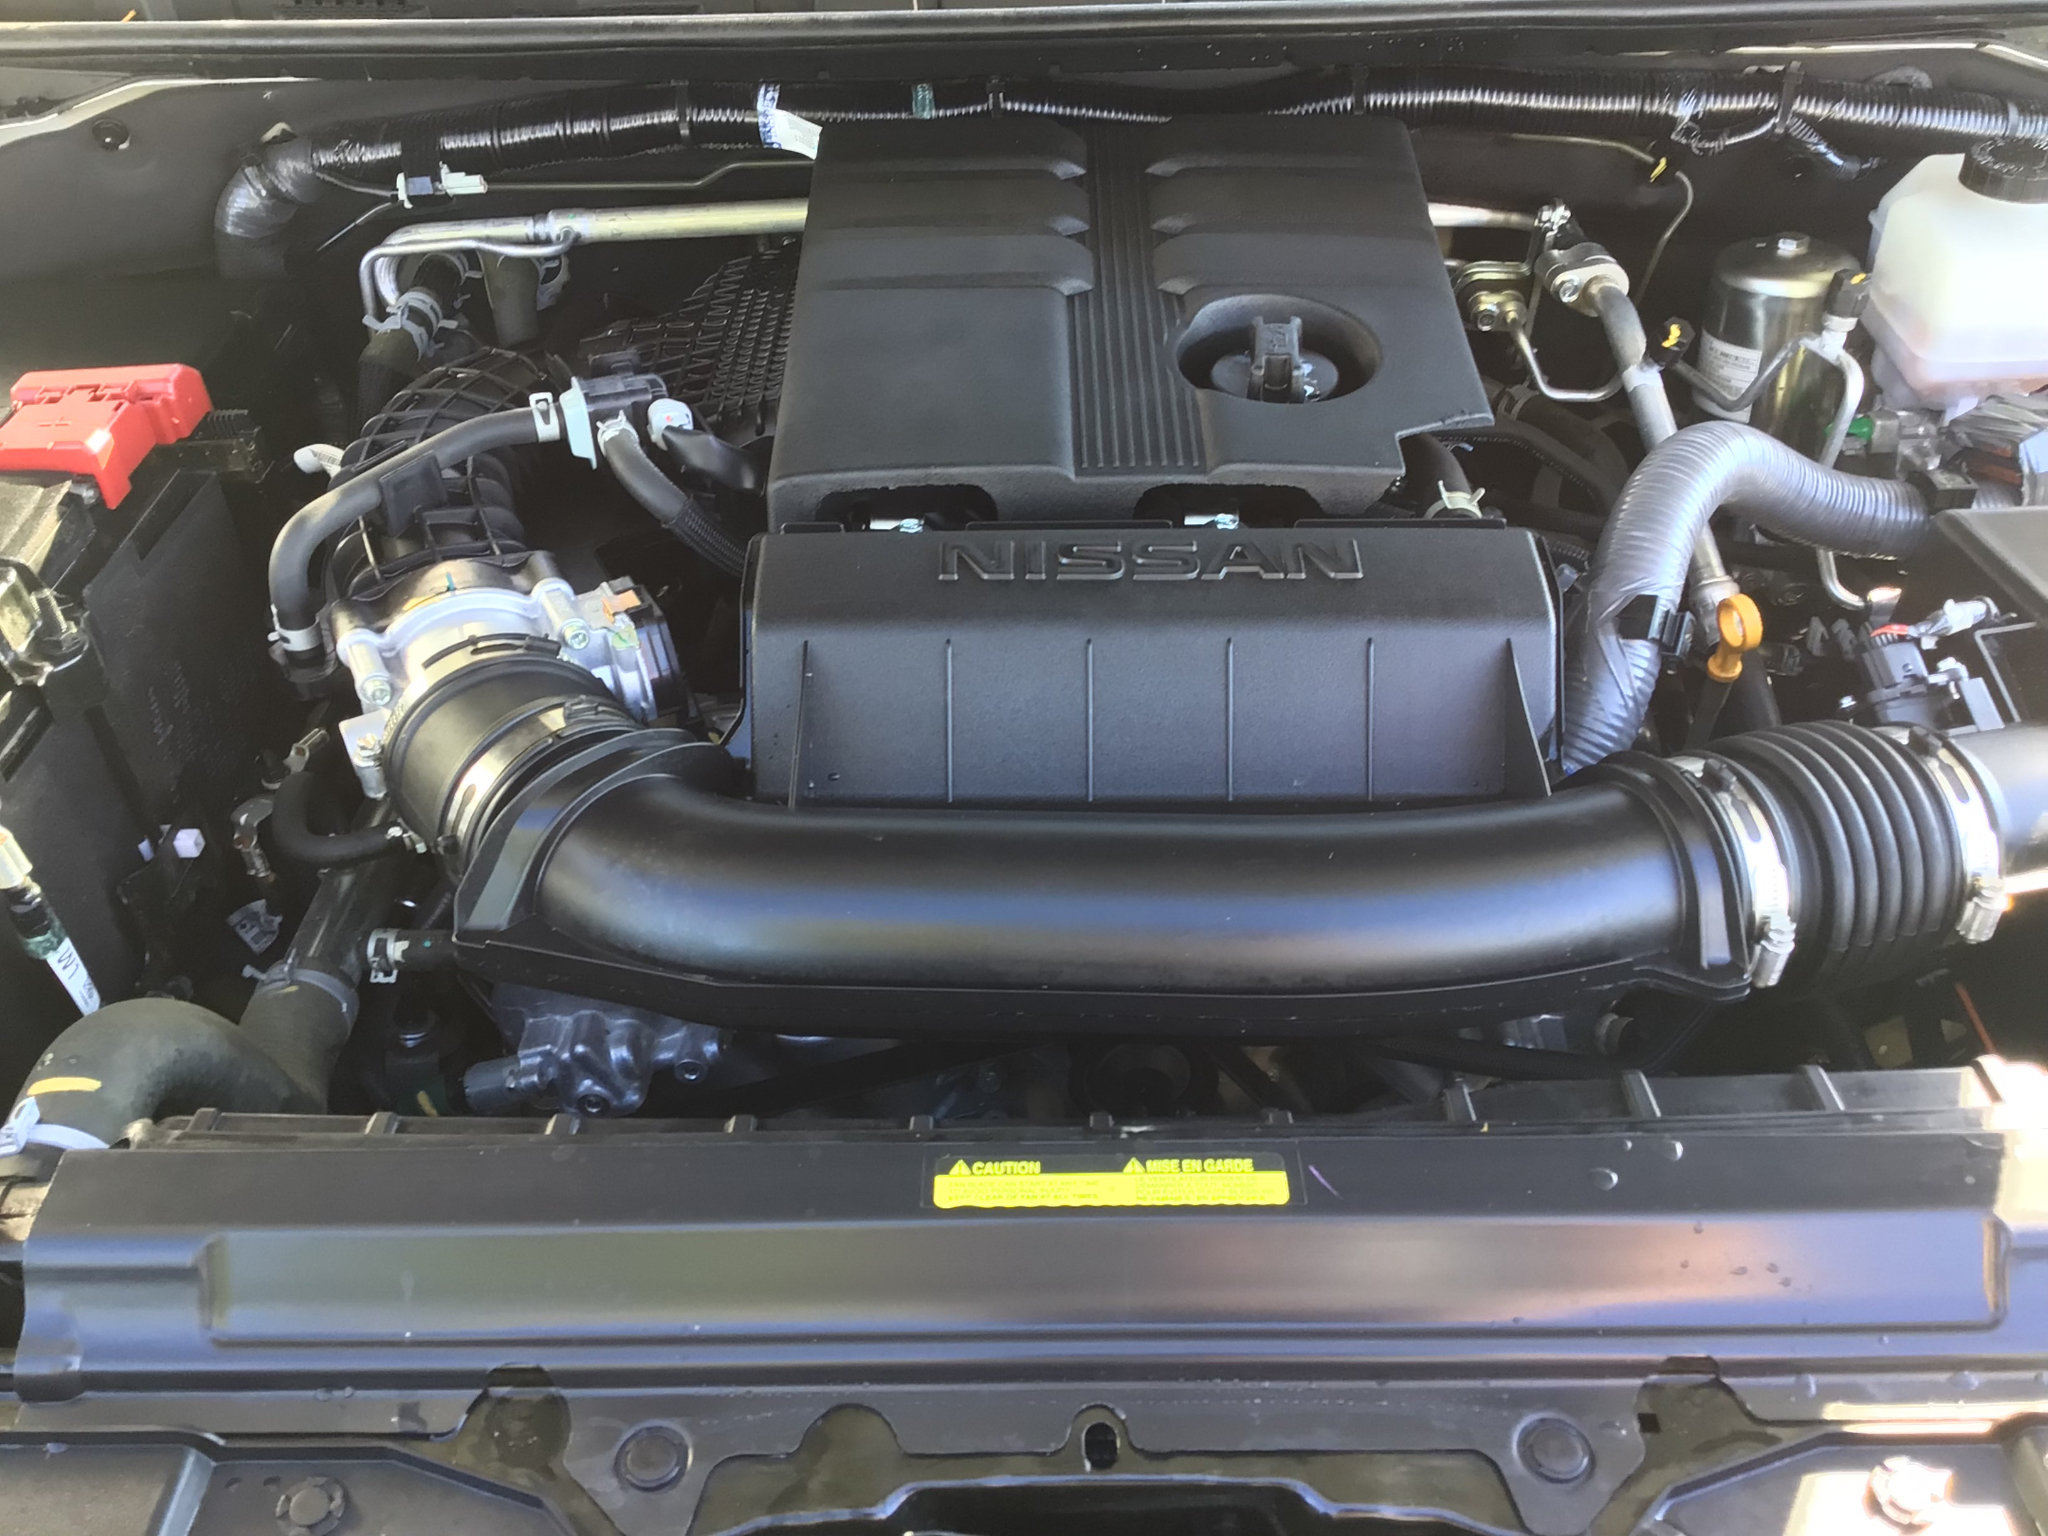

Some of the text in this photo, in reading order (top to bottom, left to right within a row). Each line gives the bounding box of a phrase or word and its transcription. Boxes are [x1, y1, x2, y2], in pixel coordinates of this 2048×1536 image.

[937, 537, 1364, 581] NISSAN
[972, 1160, 1041, 1175] CAUTION
[1145, 1158, 1254, 1173] MISE EN GARDE
